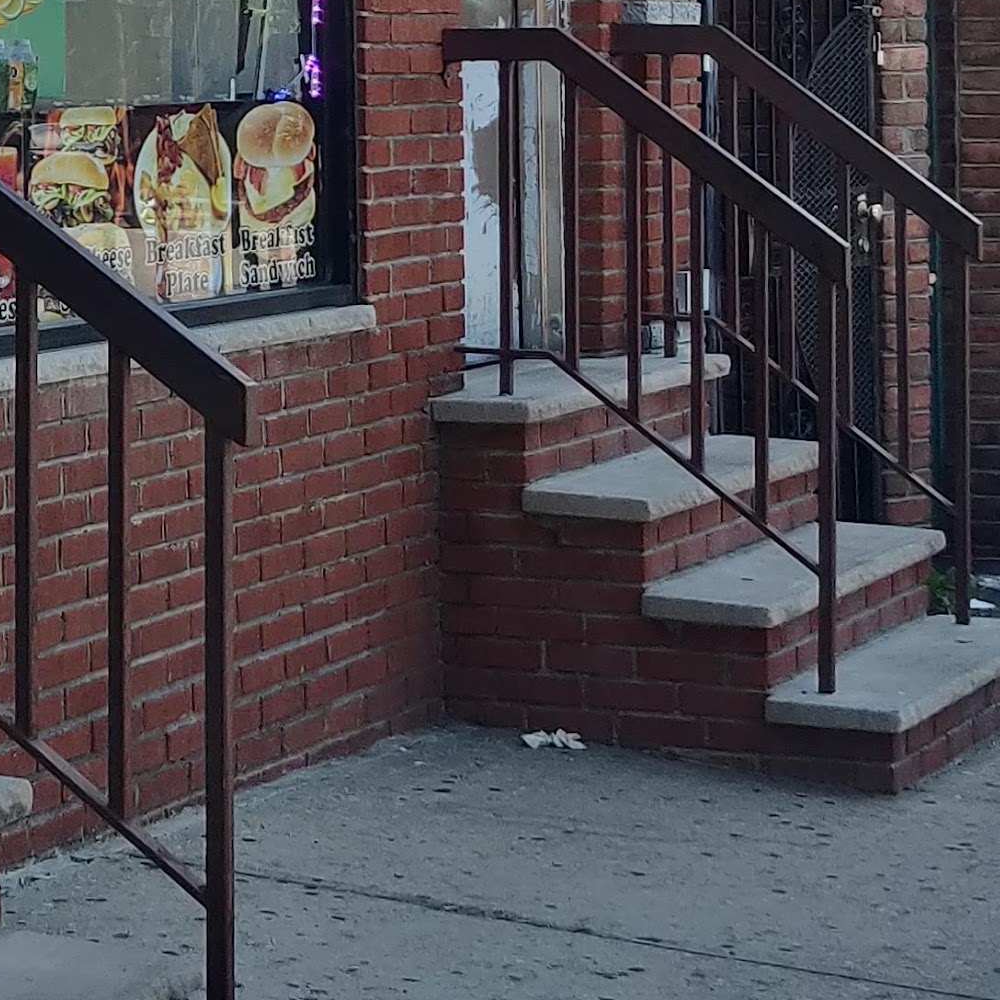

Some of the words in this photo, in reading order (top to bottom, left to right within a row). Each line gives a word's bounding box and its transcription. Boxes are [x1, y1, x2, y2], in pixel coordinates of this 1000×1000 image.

[145, 233, 226, 265] Breakfast
[166, 270, 209, 297] Plate
[240, 251, 316, 286] Sandwich
